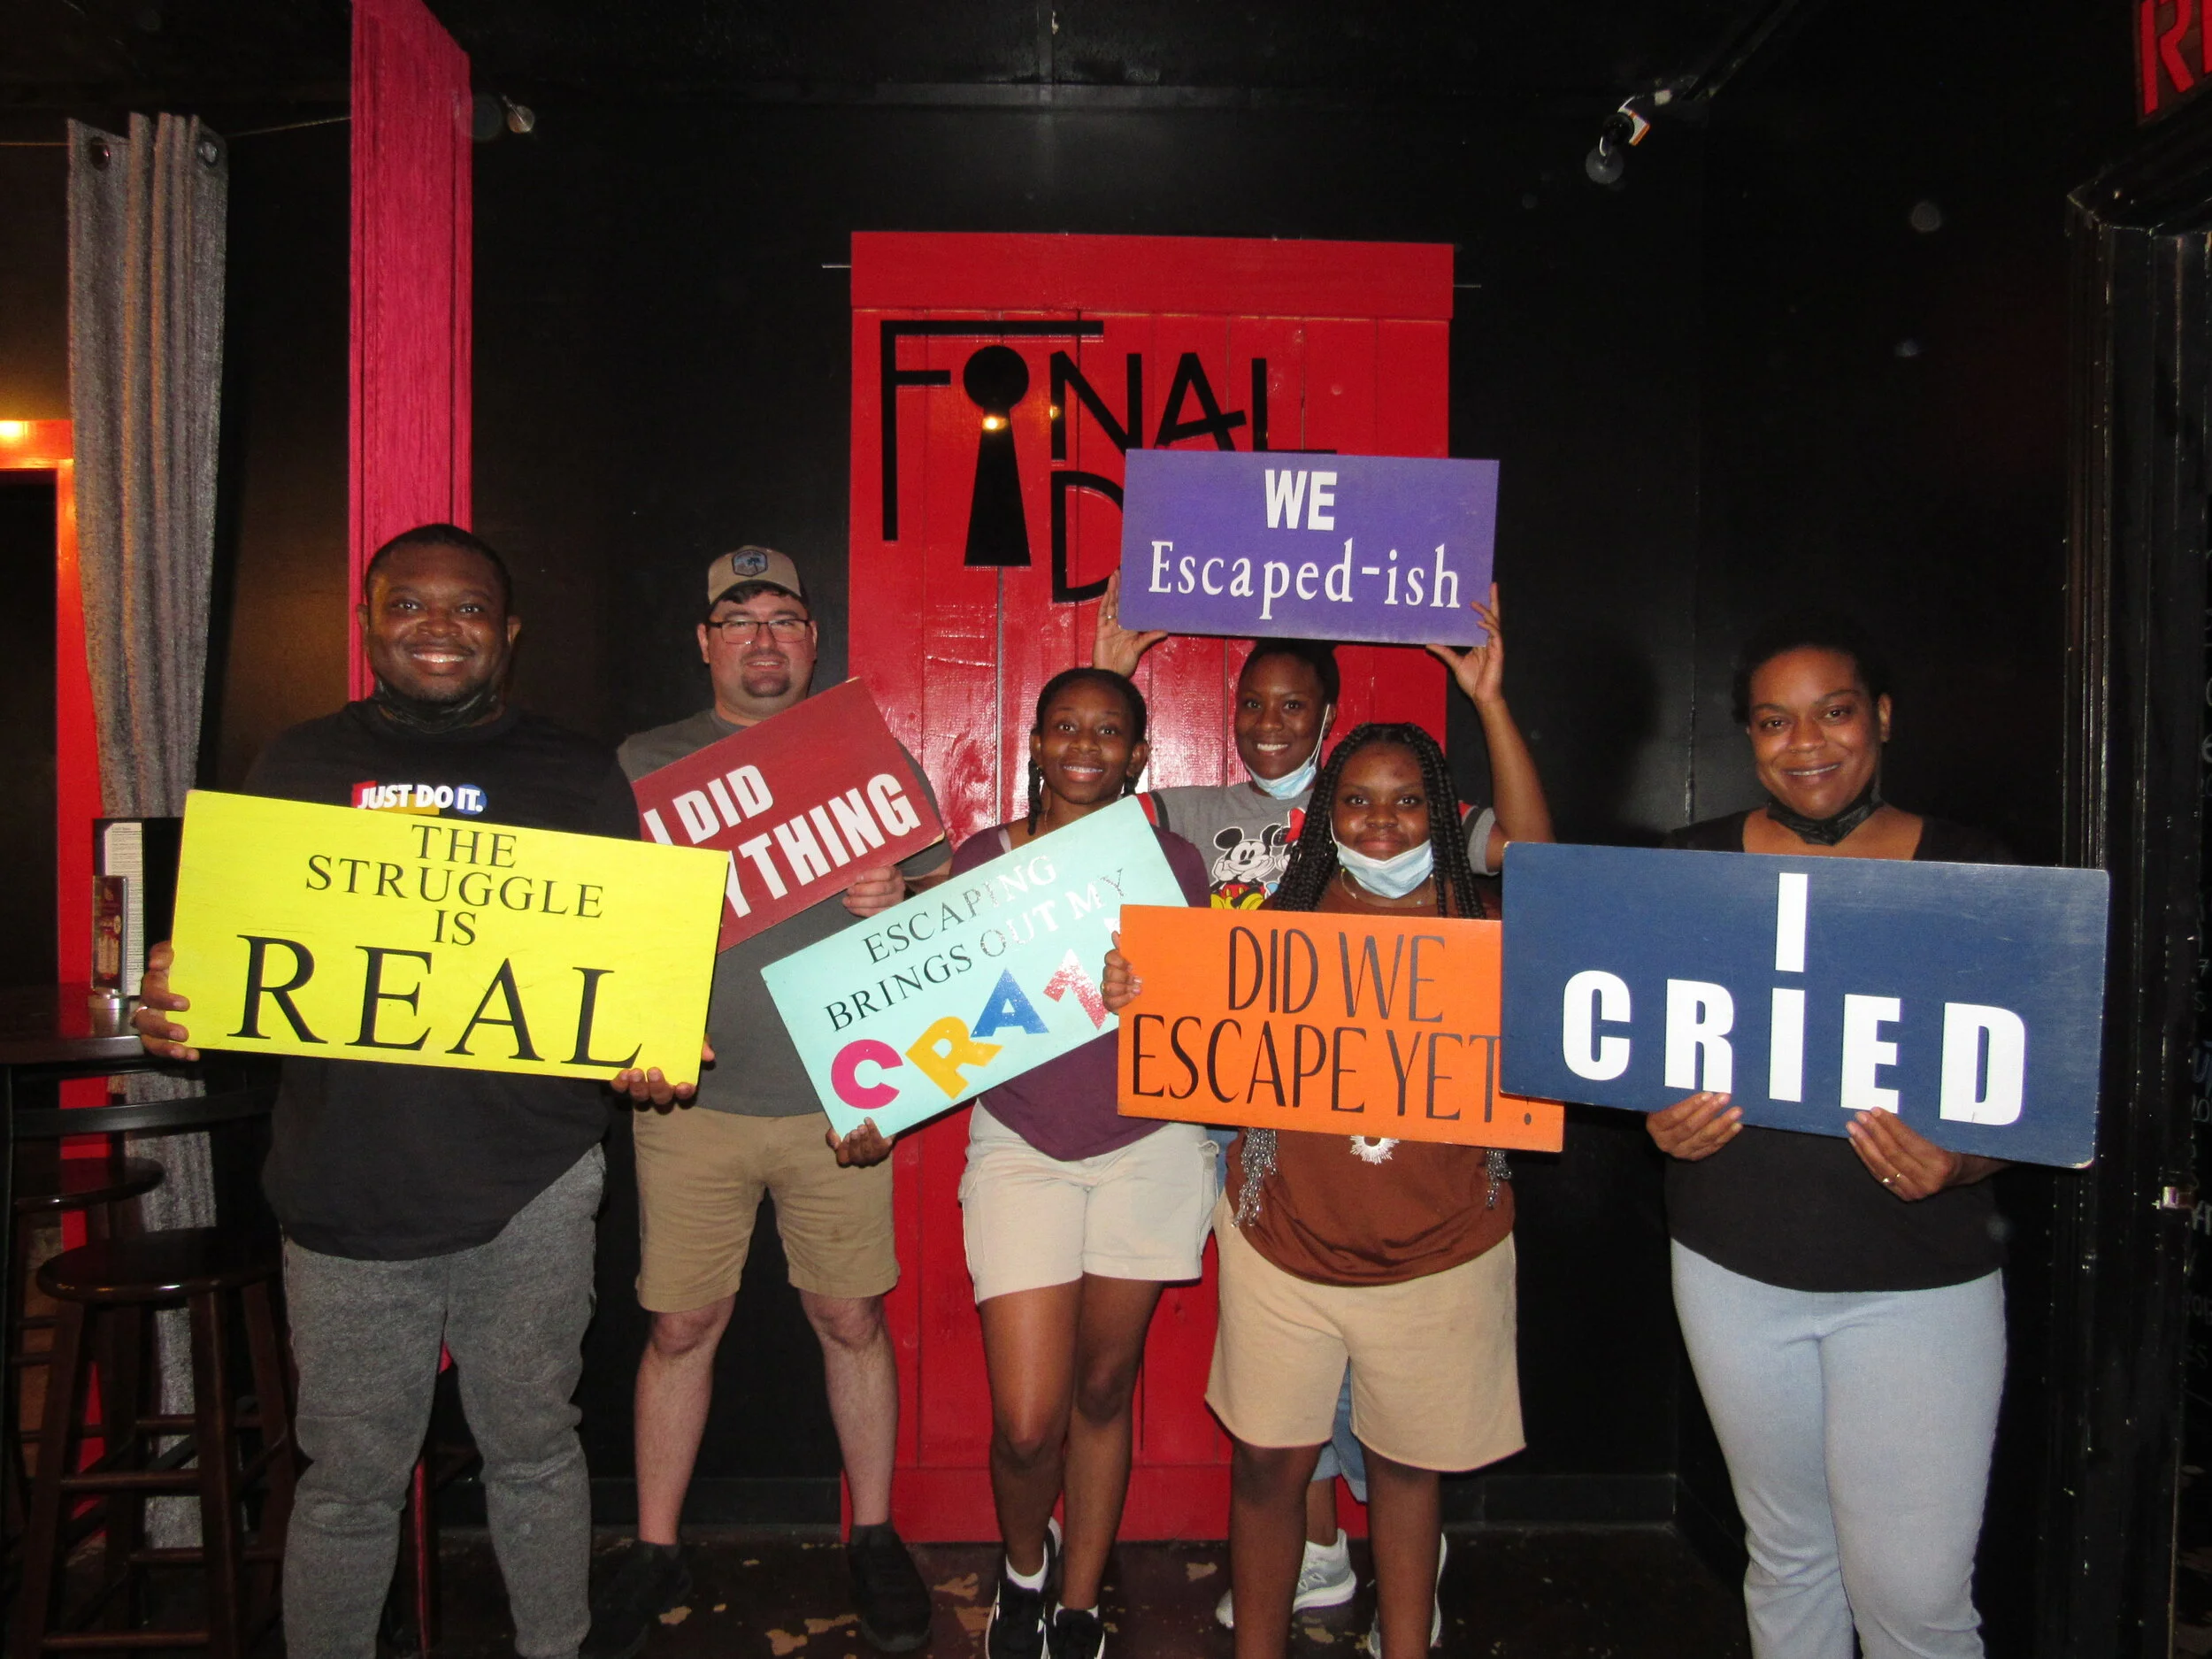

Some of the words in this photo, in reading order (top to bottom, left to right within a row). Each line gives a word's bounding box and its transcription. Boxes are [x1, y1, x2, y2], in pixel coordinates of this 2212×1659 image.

[1265, 469, 1337, 531] WE
[1148, 538, 1461, 619] Escaped-ish
[357, 784, 412, 810] JUST
[416, 784, 454, 809] DO
[457, 787, 484, 812] IT.
[643, 809, 673, 845] I
[672, 764, 773, 844] DID
[306, 855, 603, 918] STRUGGLE
[411, 824, 517, 868] THE
[431, 910, 477, 946] IS
[824, 944, 972, 1033] BRINGS
[979, 900, 1060, 957] OUT
[1065, 868, 1125, 919] MY
[863, 855, 1057, 964] ESCAPING
[1775, 872, 1808, 972] I
[227, 934, 643, 1069] REAL
[1228, 926, 1318, 1014] DID
[1339, 932, 1445, 1023] WE
[1133, 1014, 1367, 1113] ESCAPE
[1386, 1029, 1532, 1125] YET
[1563, 971, 2026, 1126] CRIED
